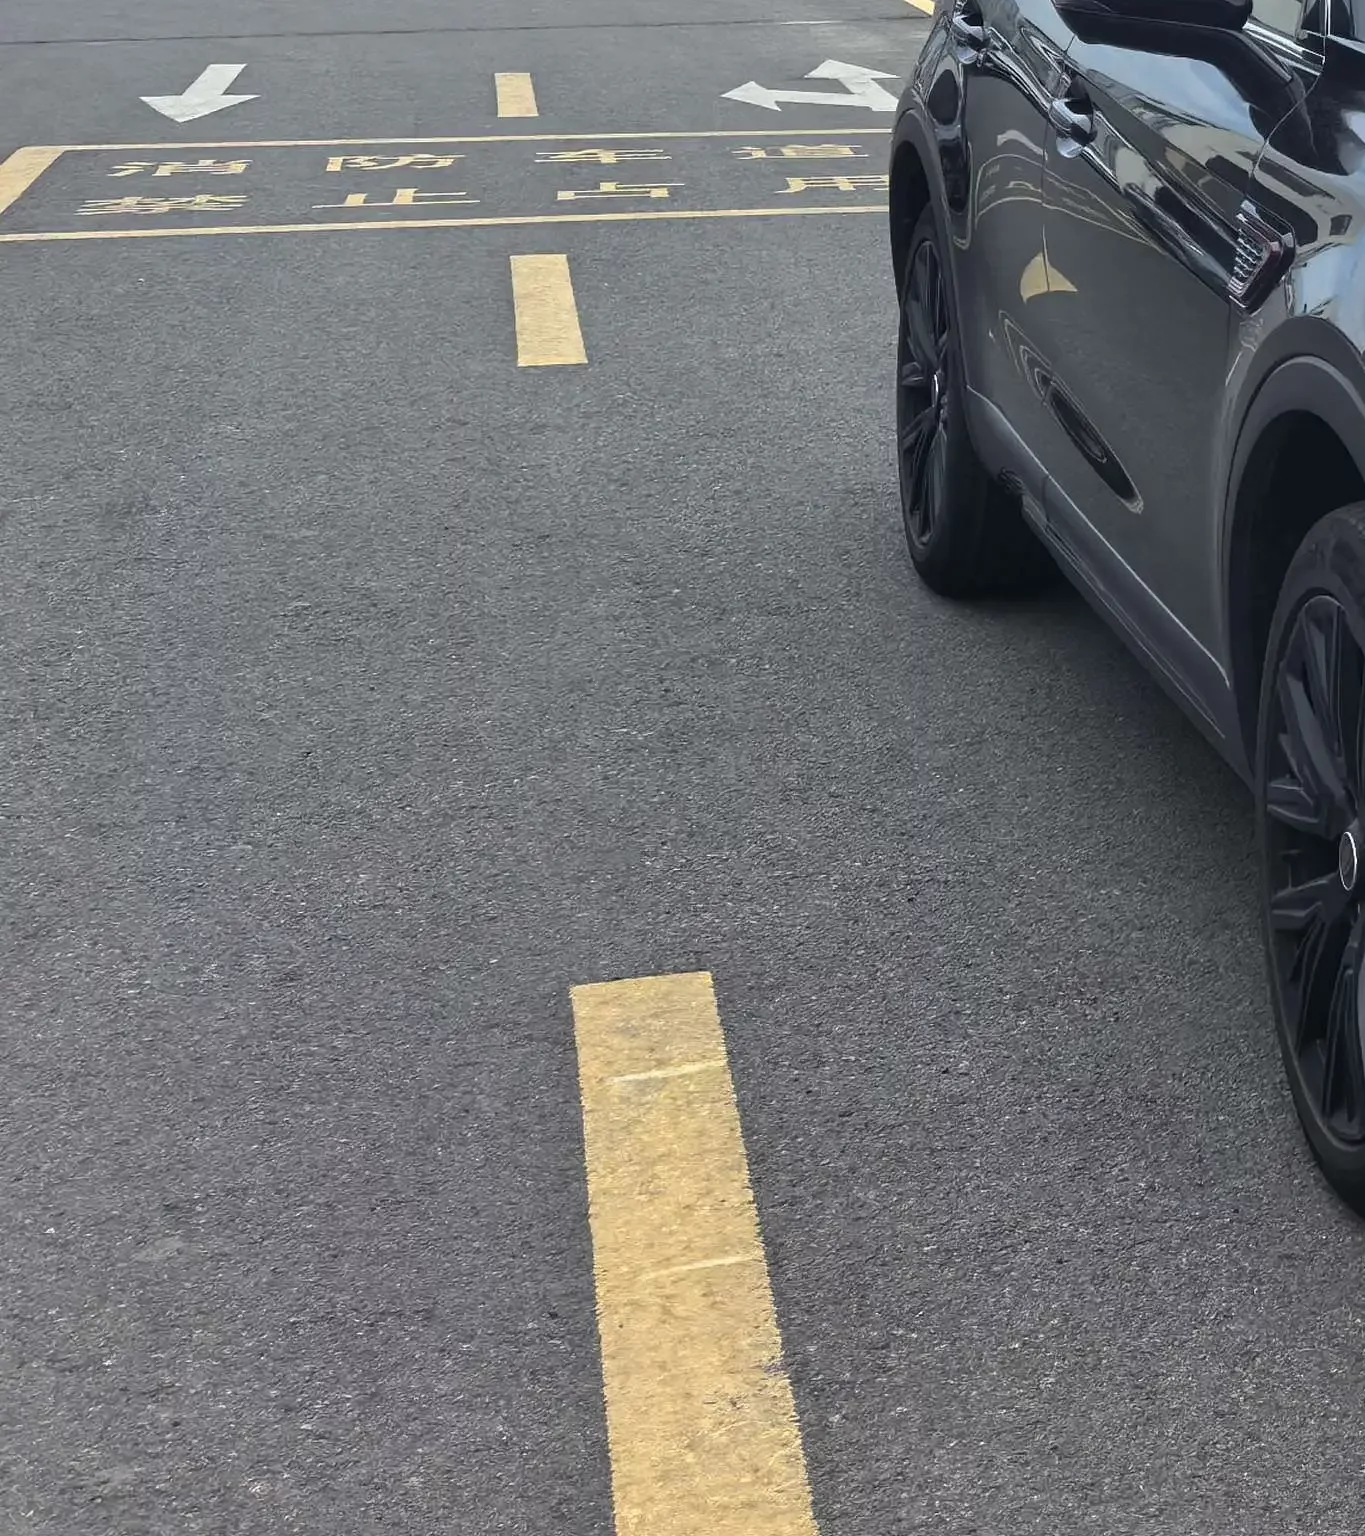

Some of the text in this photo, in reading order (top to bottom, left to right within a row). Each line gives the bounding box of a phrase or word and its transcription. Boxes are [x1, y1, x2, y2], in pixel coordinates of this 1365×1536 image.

[109, 144, 868, 178] 消防车道
[75, 174, 890, 216] 禁止占用
